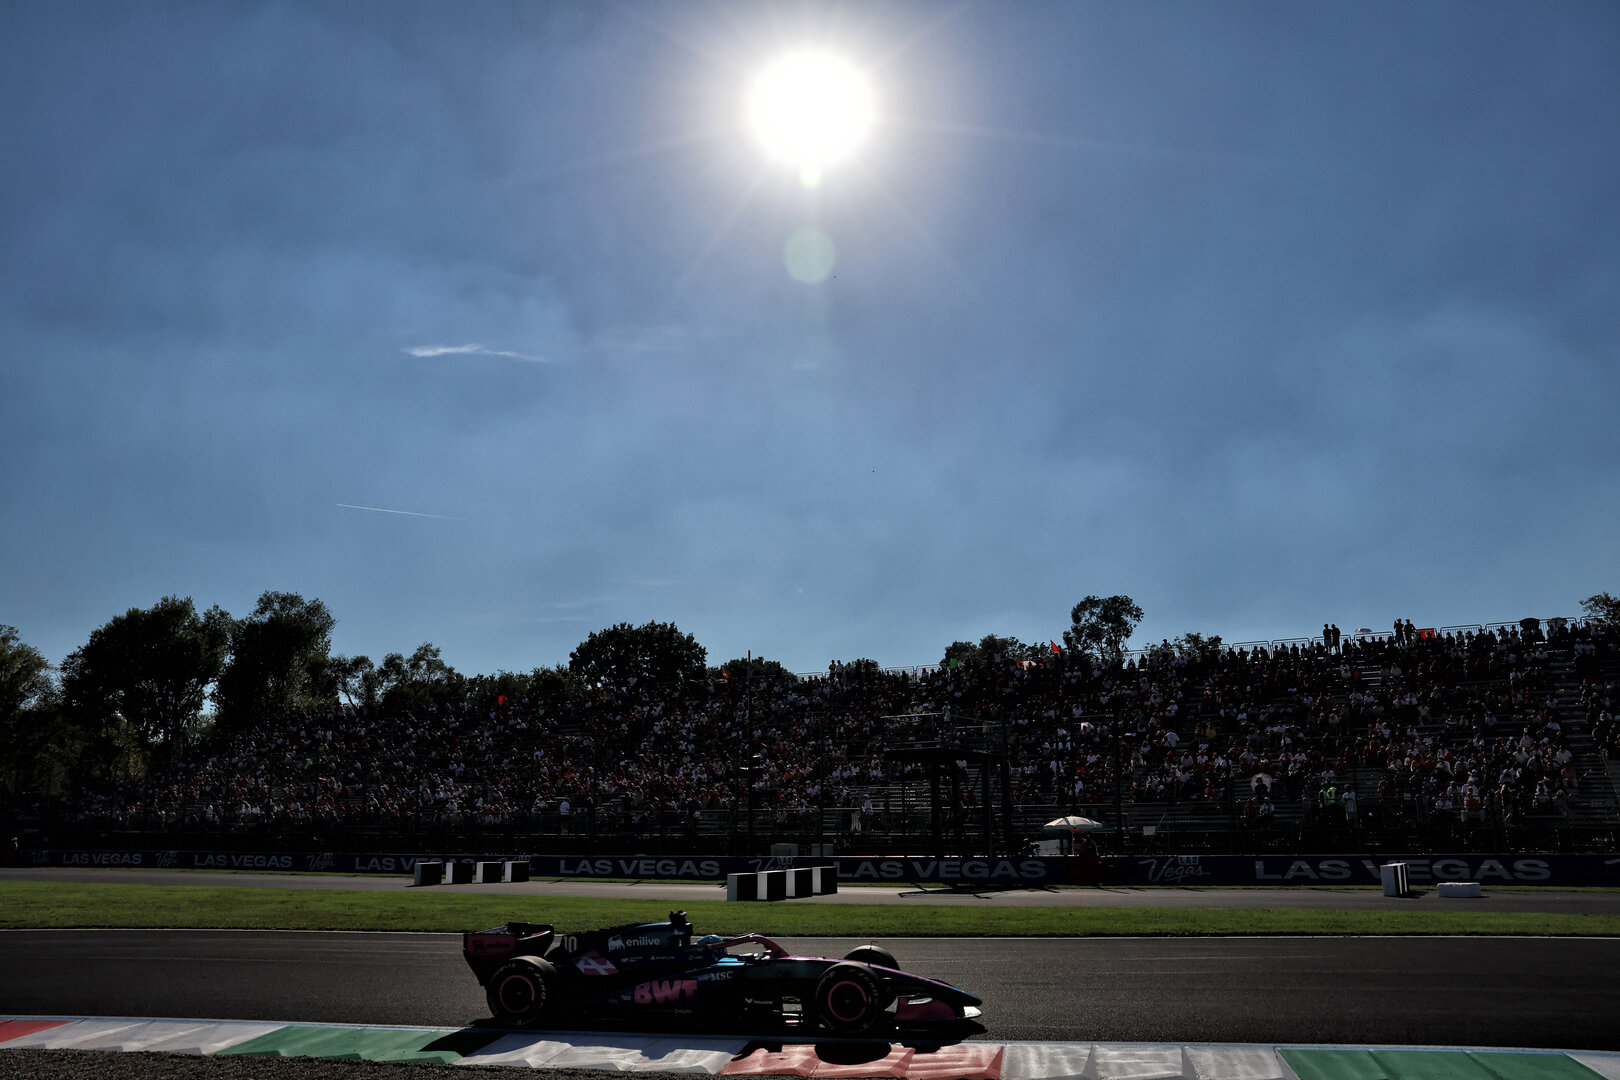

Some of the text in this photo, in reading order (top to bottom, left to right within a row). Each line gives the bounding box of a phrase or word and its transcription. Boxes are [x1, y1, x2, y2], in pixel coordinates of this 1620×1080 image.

[63, 853, 90, 865] LAS
[93, 853, 143, 865] VEGAS
[194, 854, 293, 868] LAS VEGAS
[355, 856, 396, 874] LAS
[1177, 855, 1200, 866] LAS
[559, 859, 721, 877] LAS VEGAS
[834, 860, 1048, 879] LAS VEGAS
[1138, 856, 1216, 884] Vegas
[1255, 859, 1353, 880] LAS
[563, 936, 578, 953] 10
[625, 935, 661, 947] enilive
[711, 970, 734, 981] MSC
[634, 979, 698, 1005] BWT
